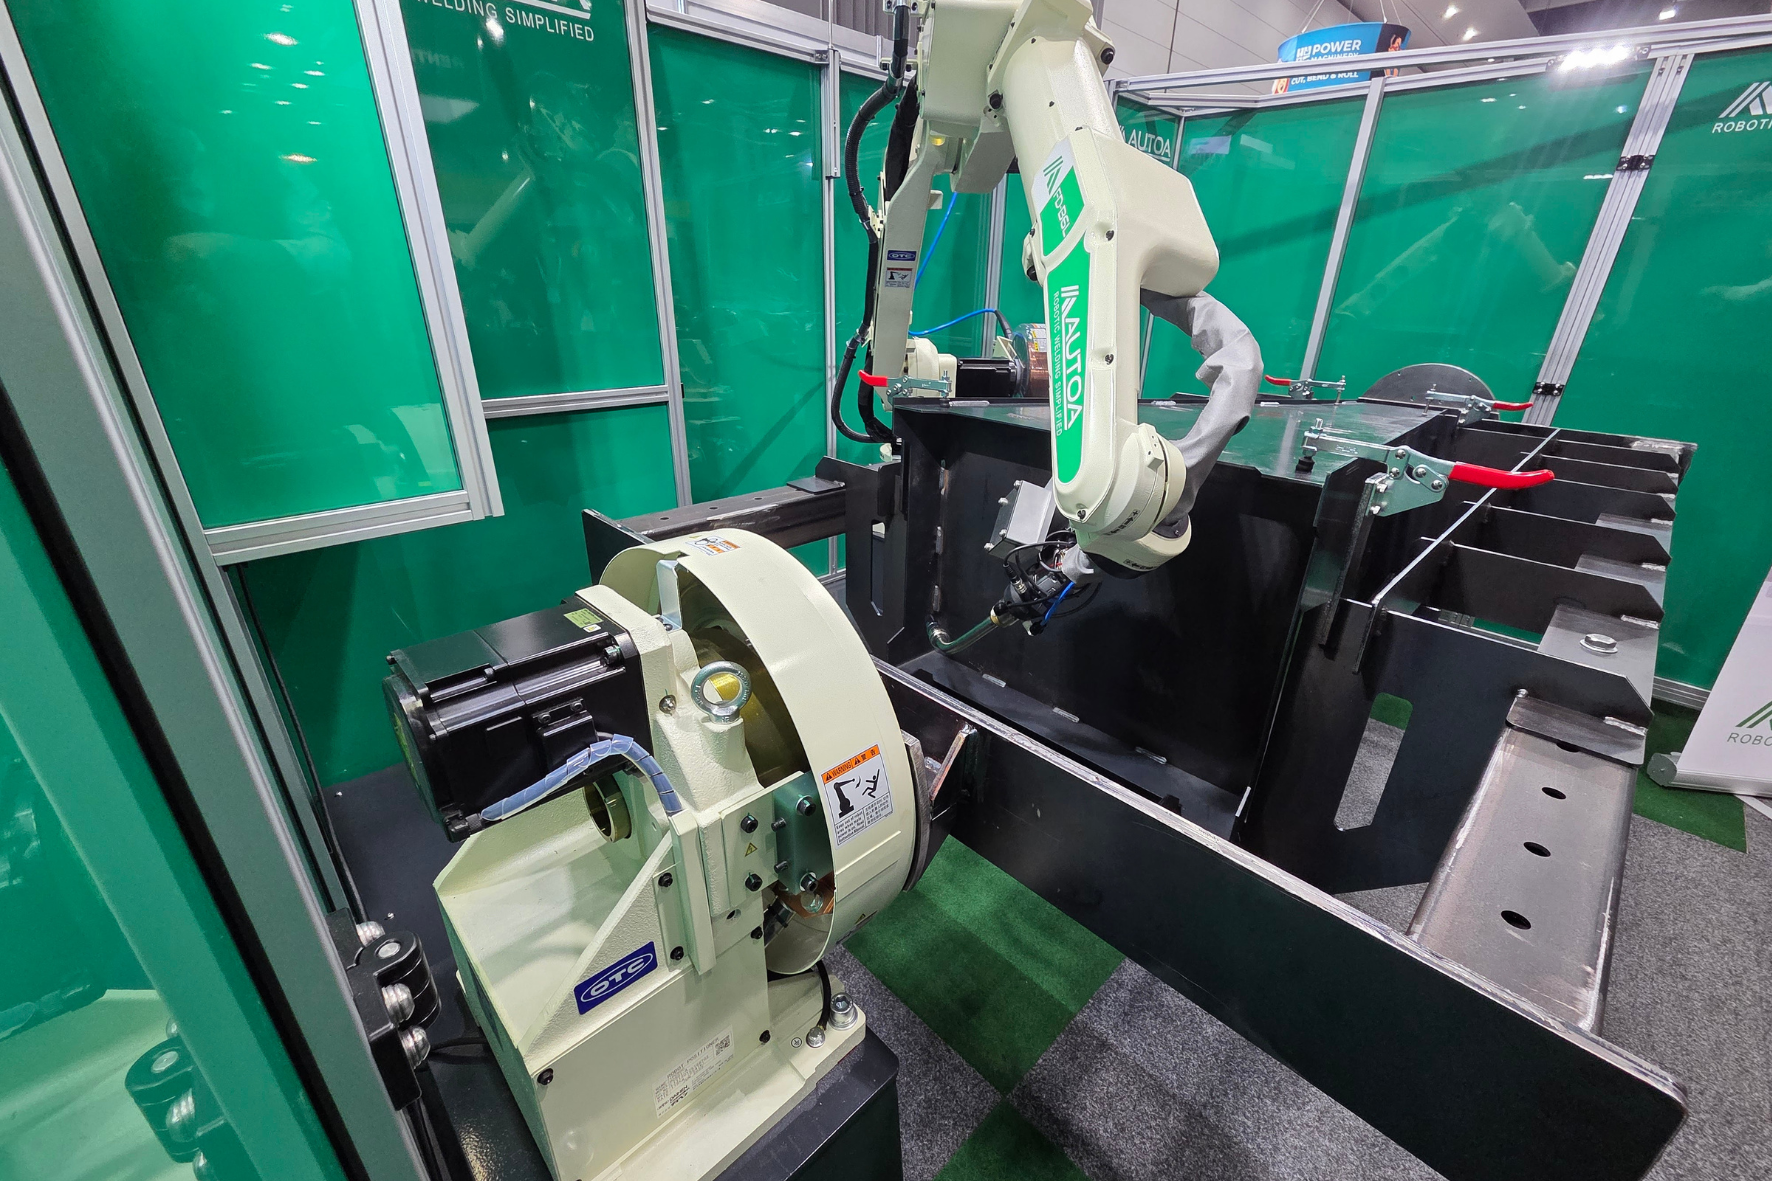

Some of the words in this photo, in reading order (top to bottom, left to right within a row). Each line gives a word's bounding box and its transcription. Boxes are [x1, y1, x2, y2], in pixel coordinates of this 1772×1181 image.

[505, 7, 594, 41] SIMPLIFIED
[1312, 40, 1361, 55] POWER
[1291, 76, 1305, 85] CUT,
[1053, 186, 1070, 238] FD-B6L
[1053, 291, 1061, 334] ROBOTIC
[1054, 334, 1062, 379] WELDING
[1055, 381, 1063, 437] SIMPLIFIED
[832, 761, 852, 777] WARNING
[590, 958, 645, 996] OTC
